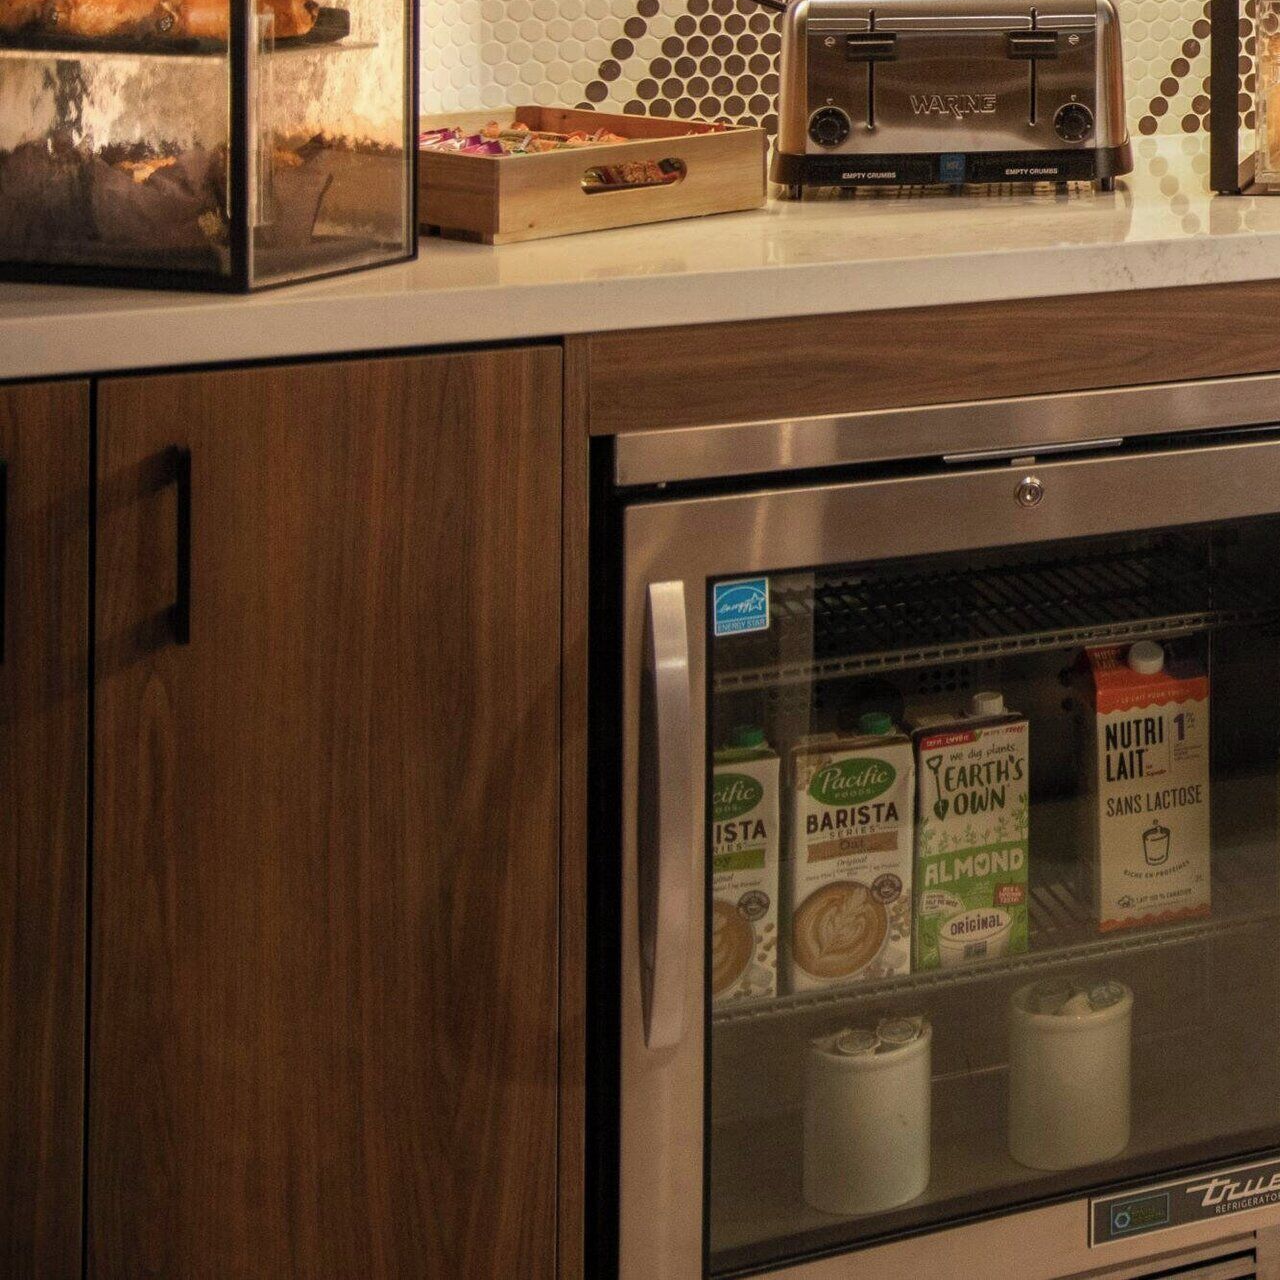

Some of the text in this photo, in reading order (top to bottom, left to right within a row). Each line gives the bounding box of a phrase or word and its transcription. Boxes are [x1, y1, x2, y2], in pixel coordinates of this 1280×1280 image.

[910, 93, 997, 119] WARING
[867, 171, 897, 179] CRUMBS
[1005, 168, 1029, 176] EMPTY
[1105, 716, 1164, 751] NUTRI
[949, 742, 1016, 762] we dig plants
[1106, 749, 1146, 782] LAIT
[818, 764, 889, 794] Pacific
[944, 755, 1025, 792] EARTH'S
[953, 785, 1006, 816] OWN
[1106, 784, 1203, 818] SANS LACTOSE
[713, 819, 768, 844] ISTA
[806, 801, 899, 835] BARISTA
[829, 826, 877, 839] SERIES
[925, 848, 1024, 887] ALMOND
